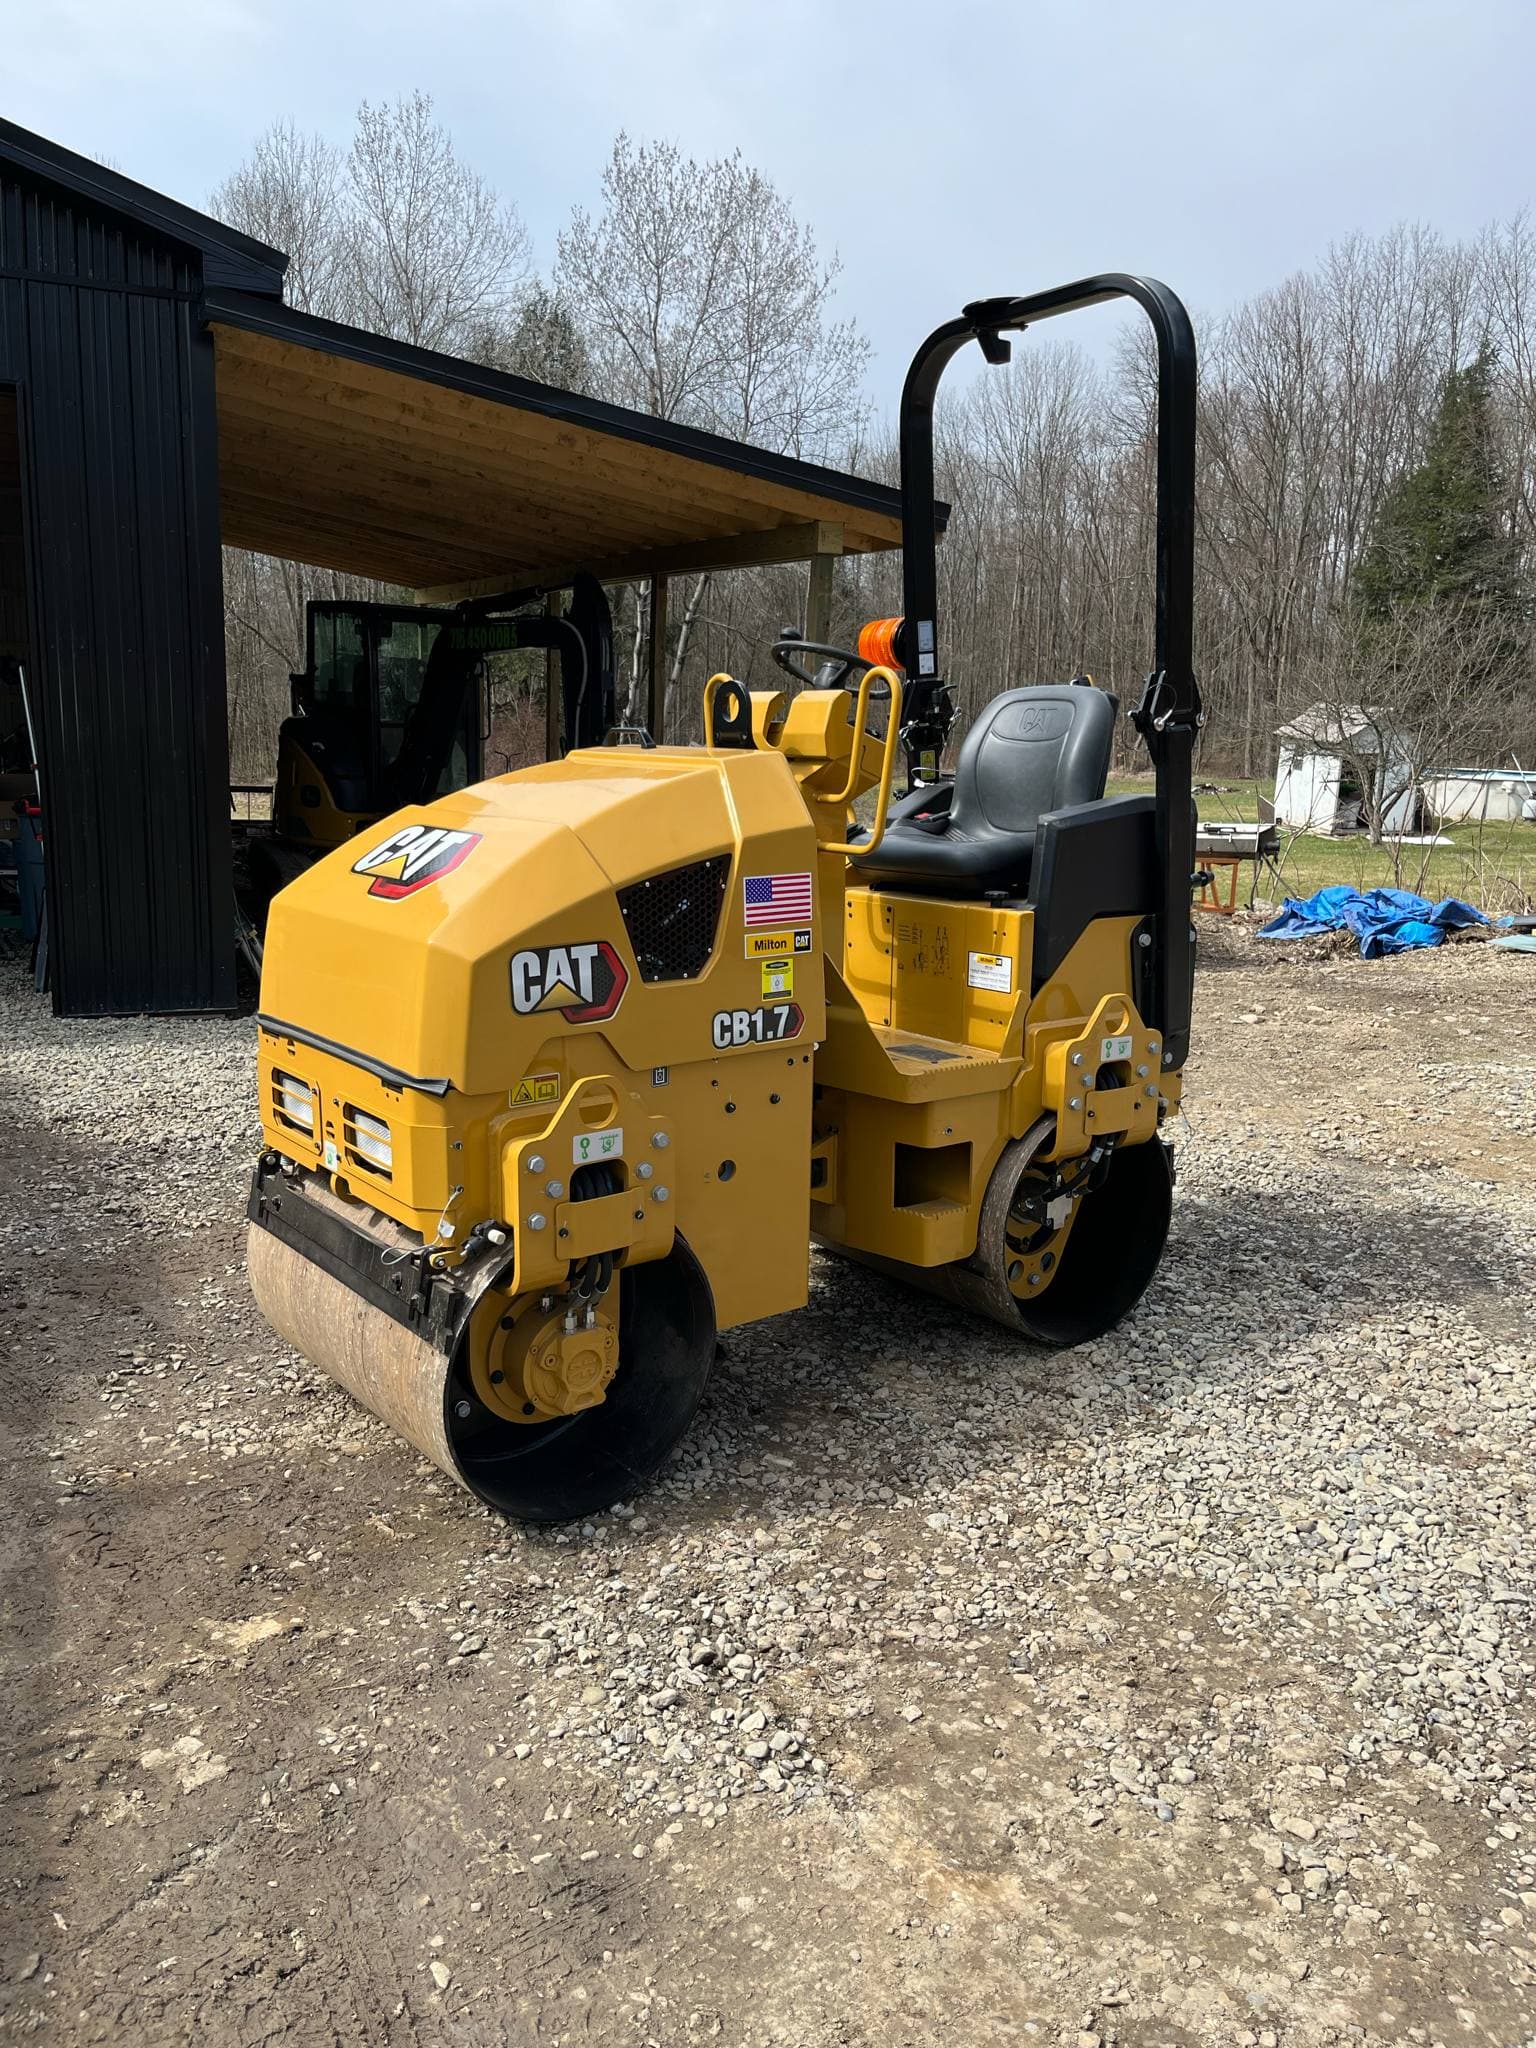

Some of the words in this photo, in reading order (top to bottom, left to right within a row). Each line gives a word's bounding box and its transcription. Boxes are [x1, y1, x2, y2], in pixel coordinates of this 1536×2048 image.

[1019, 708, 1058, 735] CAT
[353, 825, 475, 881] CAT
[754, 939, 787, 951] Milton
[795, 935, 809, 948] CAT
[511, 944, 598, 1013] CAT
[713, 1005, 789, 1047] CB1.7
